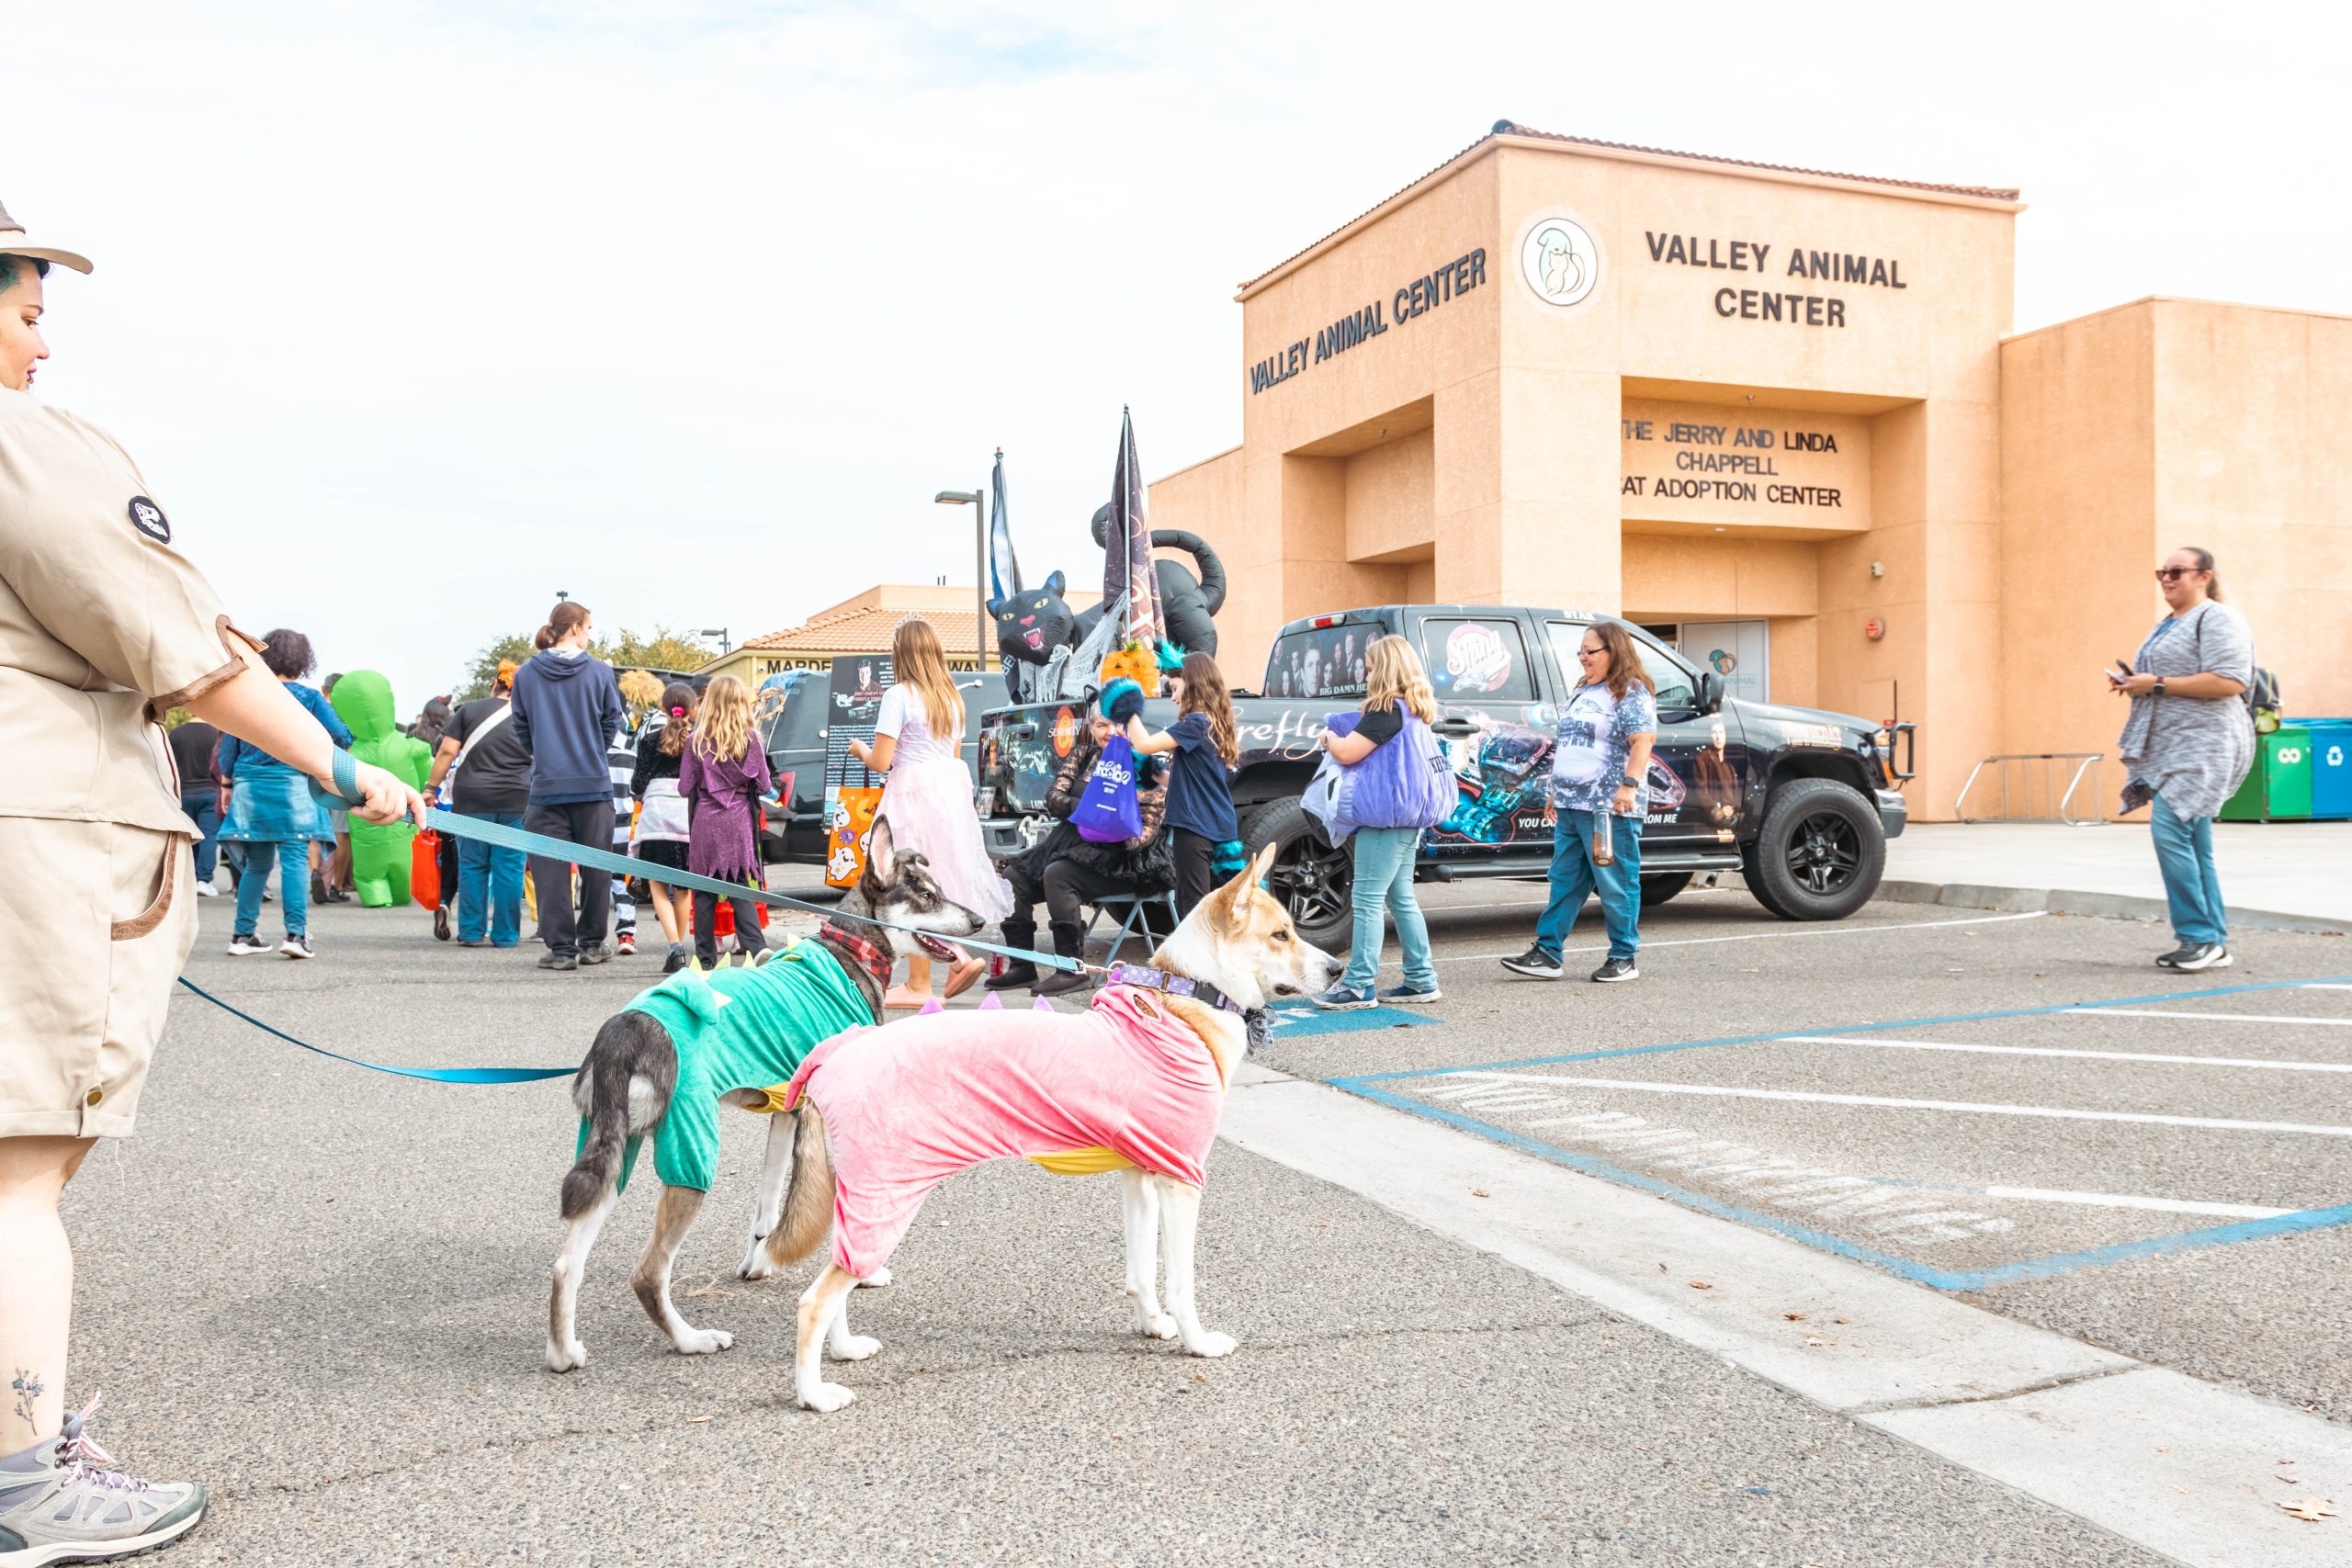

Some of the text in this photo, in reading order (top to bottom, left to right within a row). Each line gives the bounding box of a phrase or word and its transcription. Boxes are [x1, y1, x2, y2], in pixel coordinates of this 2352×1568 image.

[1645, 231, 1906, 288] VALLEY ANIMAL
[1250, 247, 1486, 395] VALLEY ANIMAL CENTER
[1715, 288, 1846, 327] CENTER
[1622, 419, 1838, 453] THE JERRY AND LINDA
[1676, 451, 1779, 476] CHAPPELL
[1621, 476, 1842, 507] AT ADOPTION CENTER
[767, 660, 831, 674] MARDE
[1319, 682, 1367, 696] BIG DAMN HE
[1233, 706, 1329, 760] refly
[1519, 818, 1539, 828] YOU
[1663, 814, 1679, 824] ME
